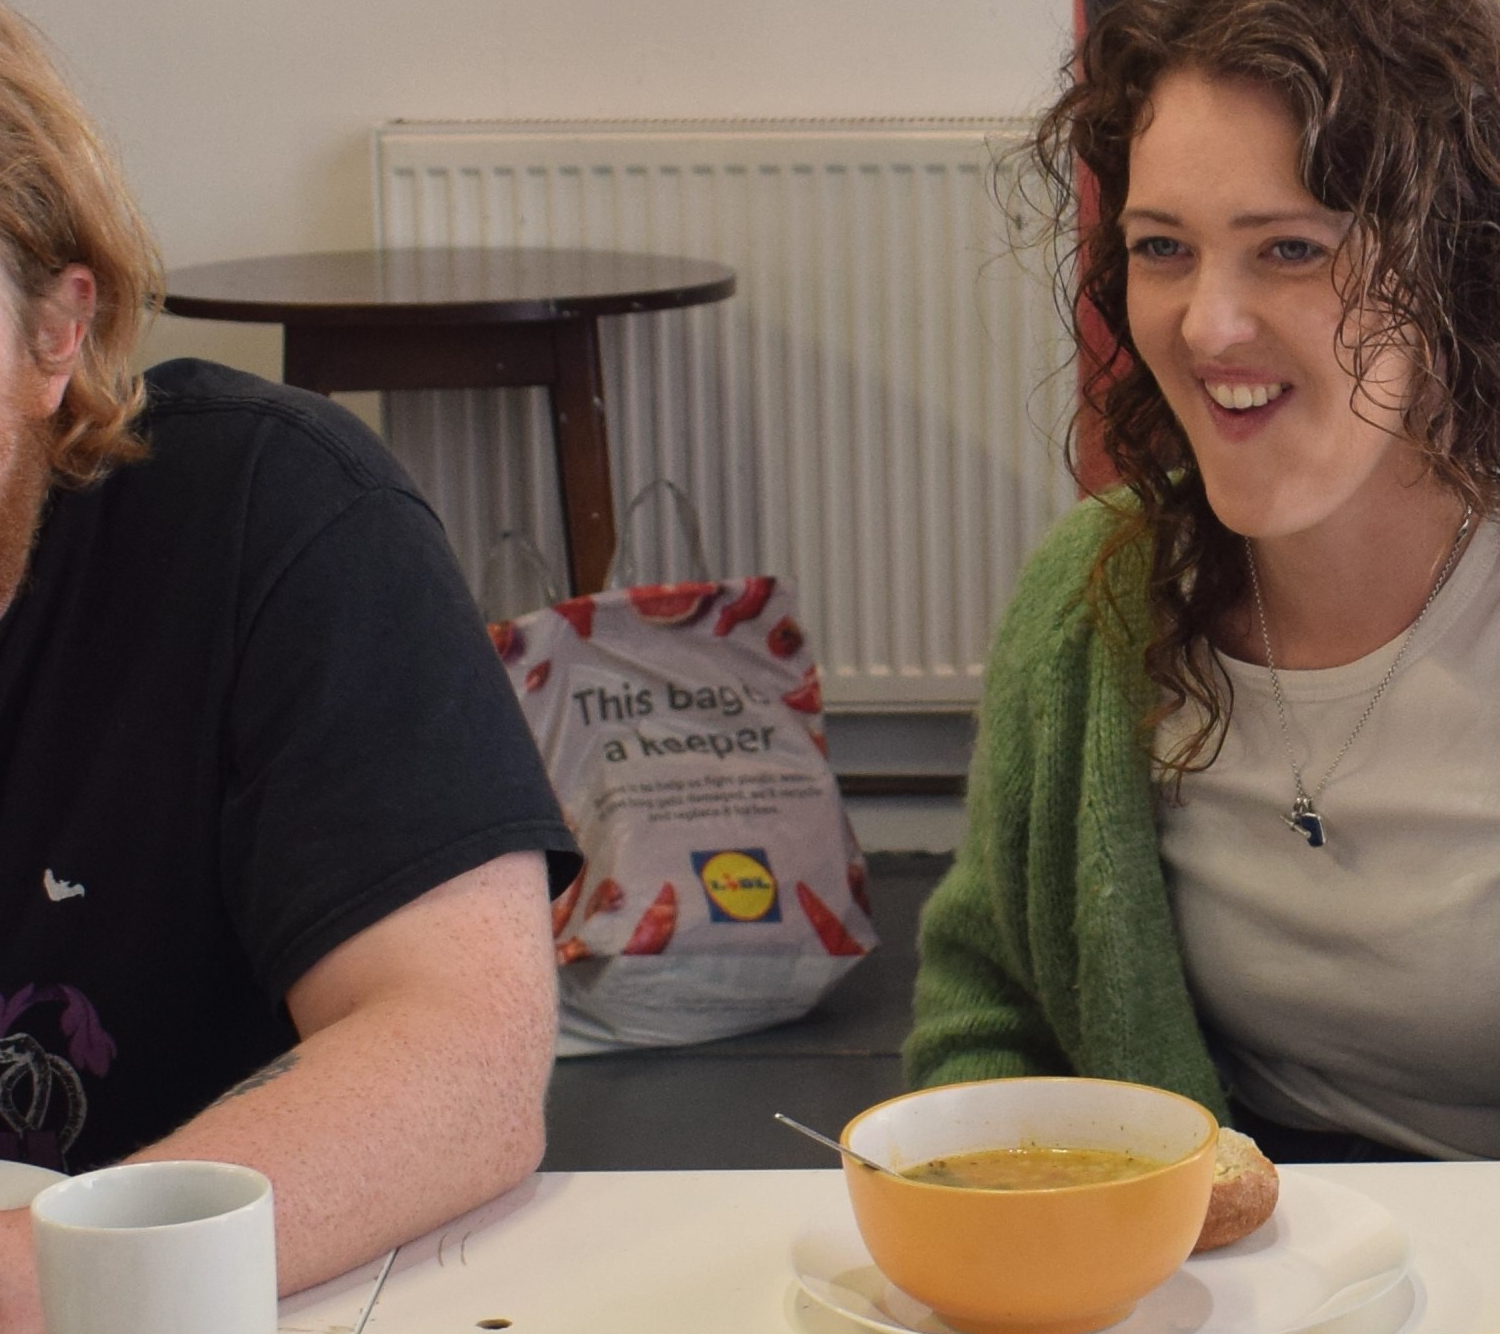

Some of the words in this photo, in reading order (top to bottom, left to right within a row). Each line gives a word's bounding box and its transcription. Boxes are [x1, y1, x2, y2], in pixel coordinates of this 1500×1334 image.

[573, 681, 653, 726] This
[604, 739, 627, 762] a
[636, 725, 775, 759] keeper
